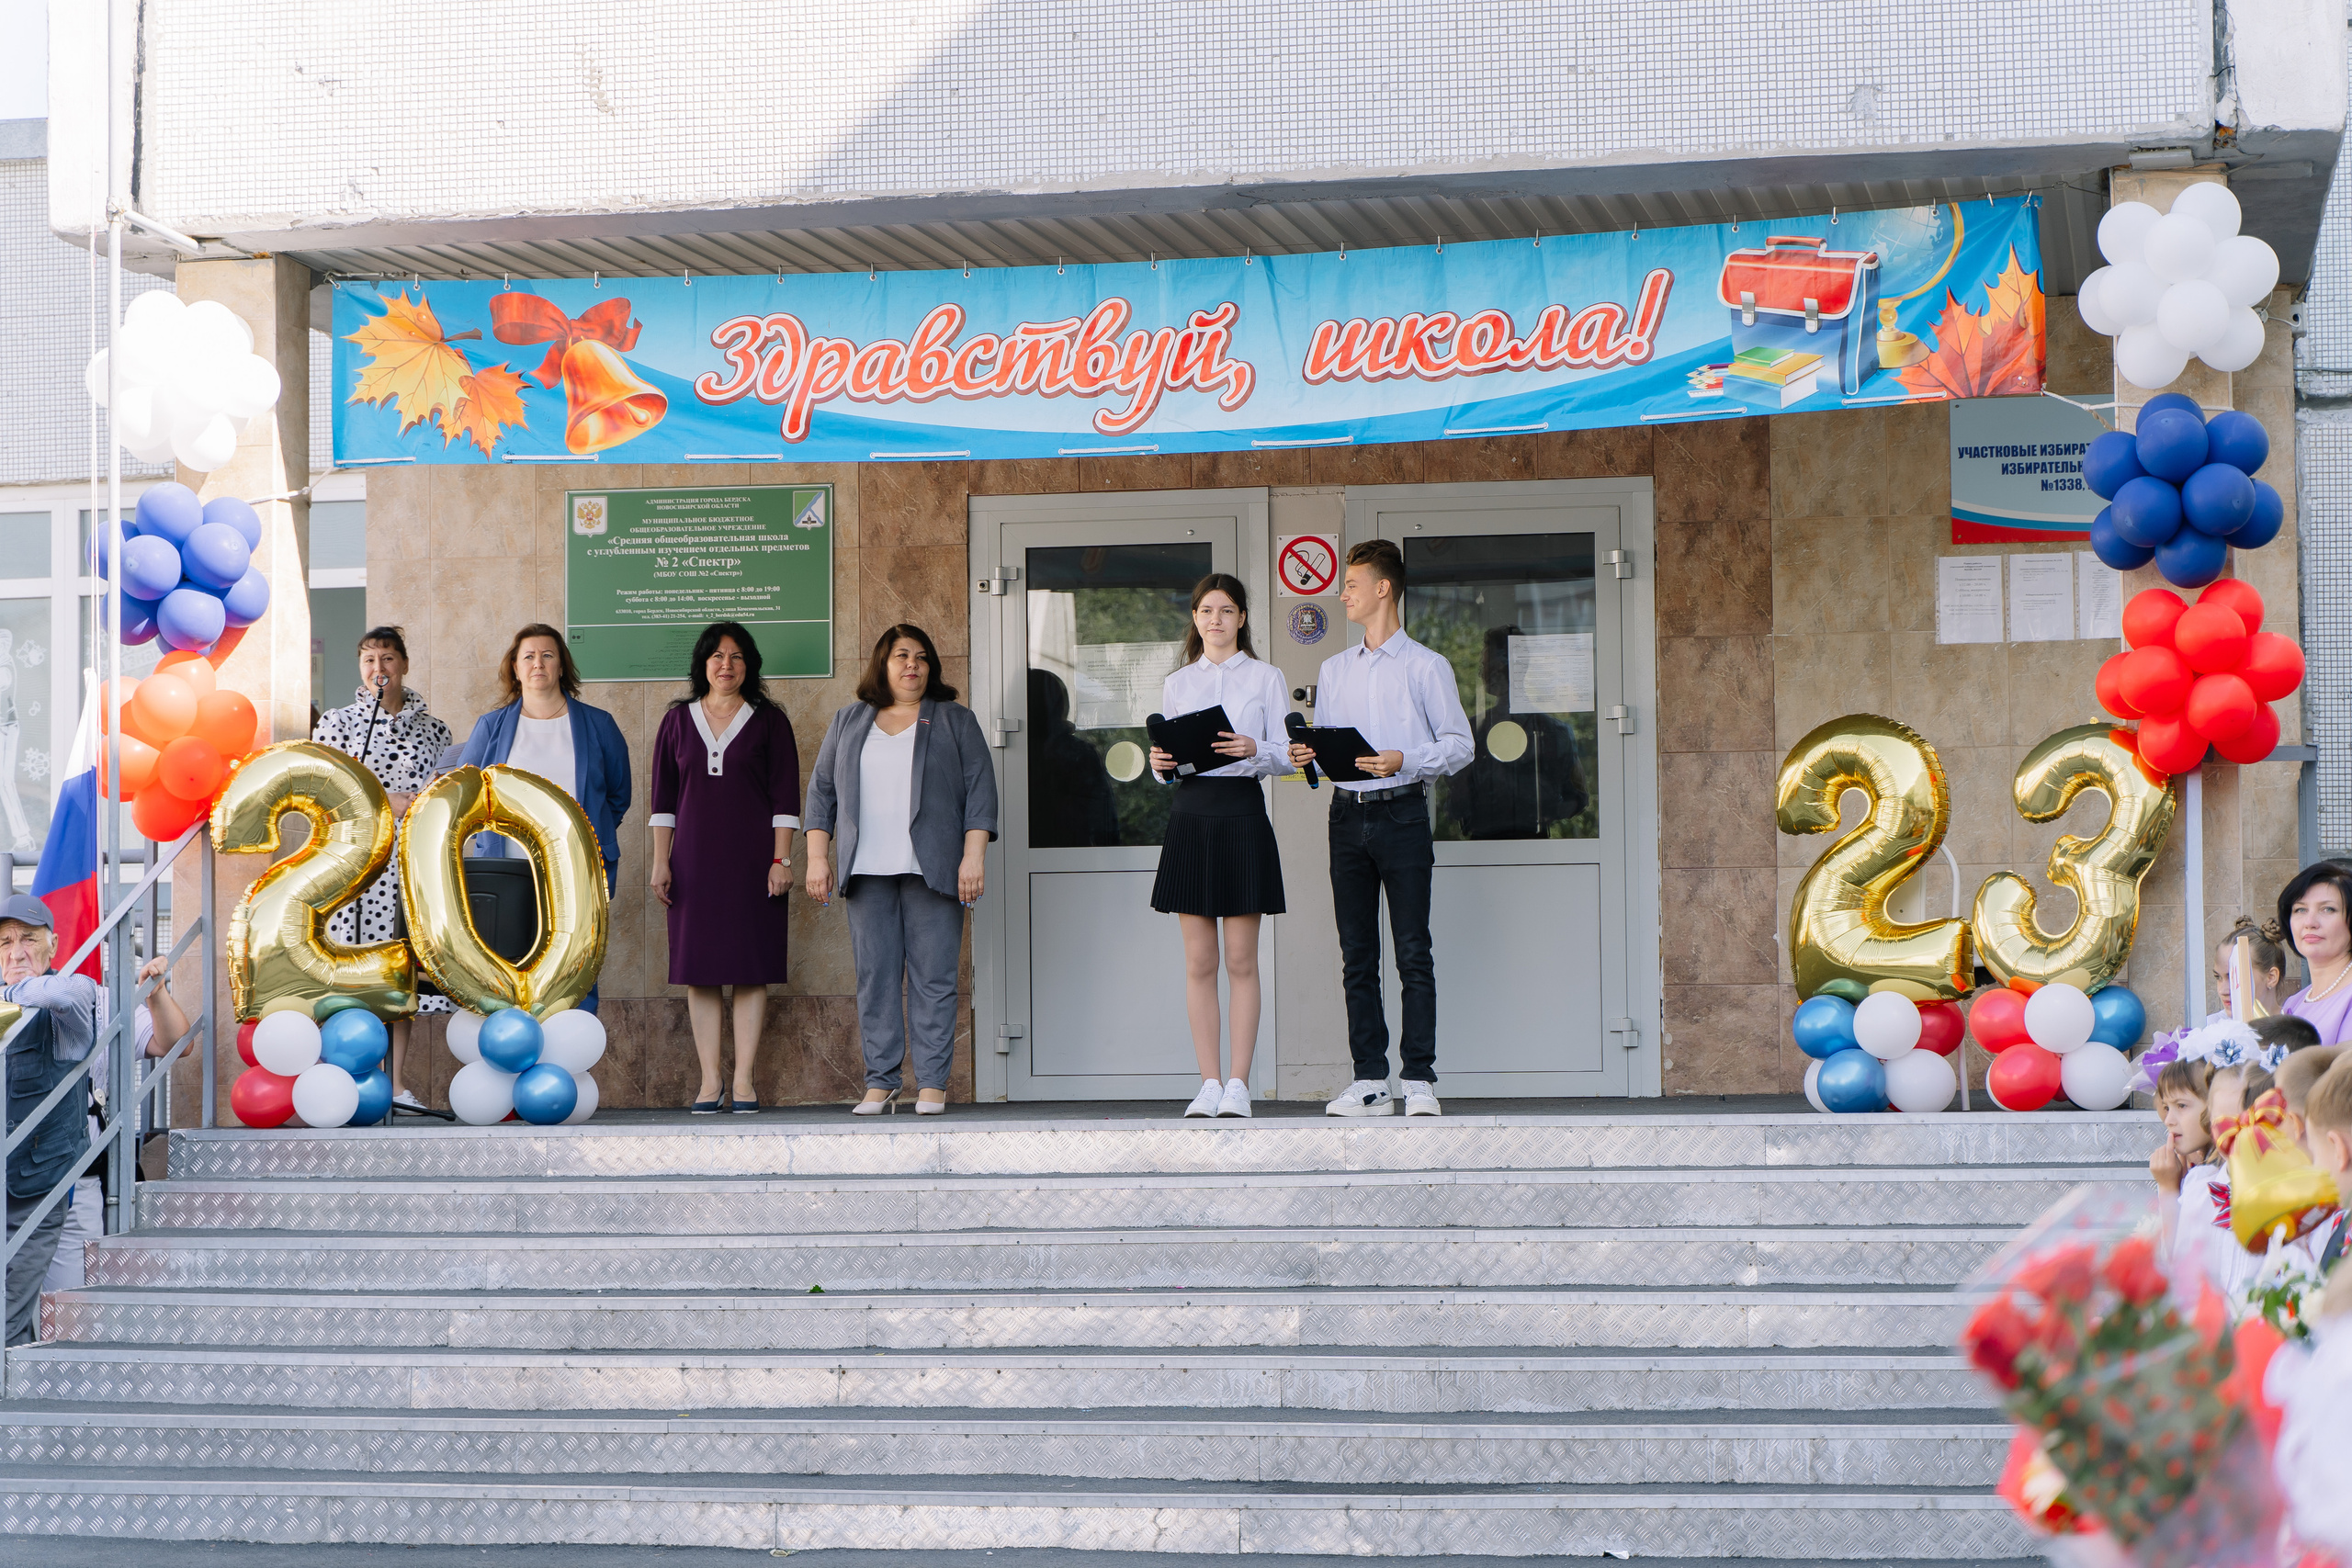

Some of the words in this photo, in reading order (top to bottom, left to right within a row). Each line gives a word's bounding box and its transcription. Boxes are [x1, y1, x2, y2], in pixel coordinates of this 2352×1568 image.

[693, 295, 1257, 445] Здравствуй,
[1301, 266, 1675, 386] школа!
[1958, 445, 2037, 458] УЧАСТКОВЫЕ
[2040, 443, 2092, 457] ИЗБИРА
[2041, 478, 2085, 491] №1338,
[630, 525, 717, 534] ОБЩЕОБРАЗОВАТЕЛЬНОЕ
[607, 536, 652, 546] «Средняя
[654, 535, 755, 545] общеобразовательная
[594, 547, 655, 558] углубленным
[658, 547, 707, 556] изучением
[708, 545, 759, 553] отдельных
[762, 544, 809, 553] предметов
[654, 557, 669, 568] №
[672, 557, 679, 567] 2
[682, 556, 741, 569] «Спектр»
